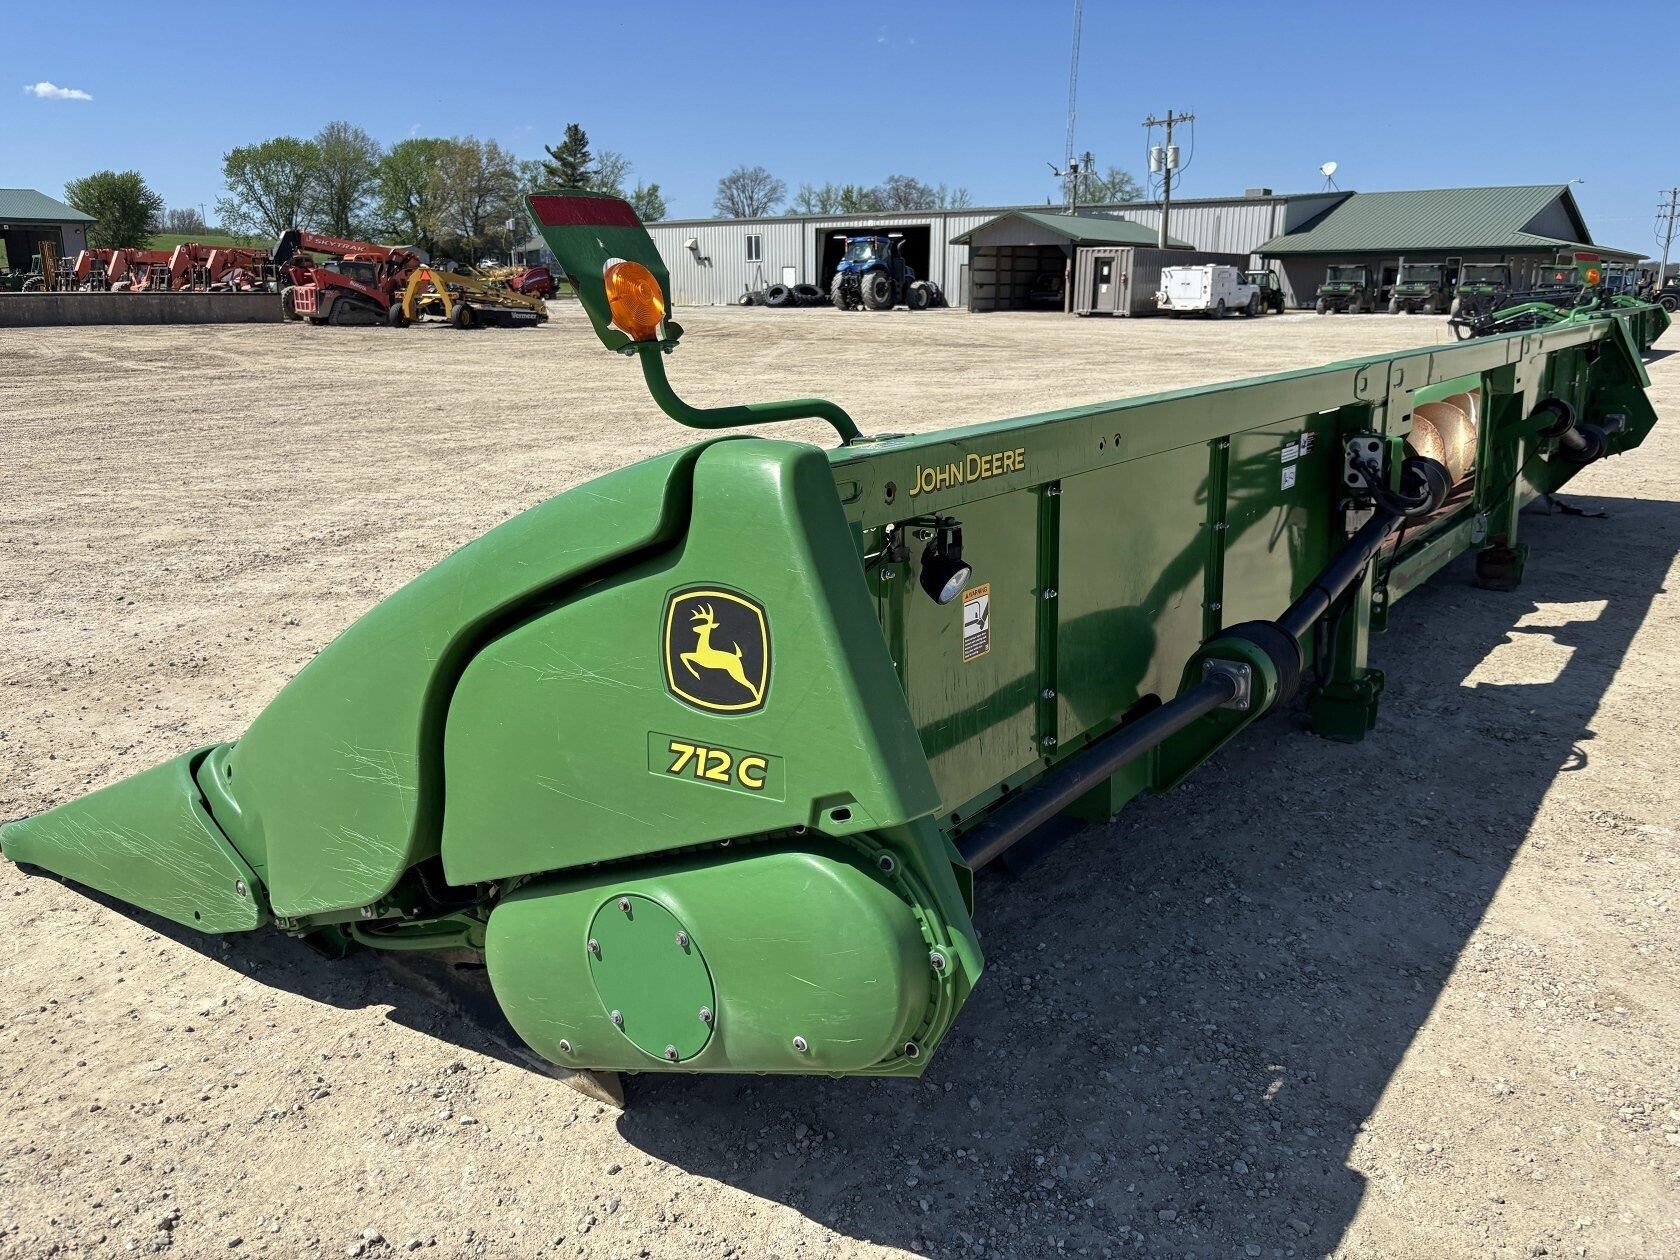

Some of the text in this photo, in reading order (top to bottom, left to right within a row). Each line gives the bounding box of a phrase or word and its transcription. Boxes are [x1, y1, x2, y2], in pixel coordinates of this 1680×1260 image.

[315, 239, 367, 252] SKYTRAK
[511, 312, 538, 320] Vermeer
[909, 447, 1026, 496] JOHN DEERE
[667, 741, 768, 789] 712 C
